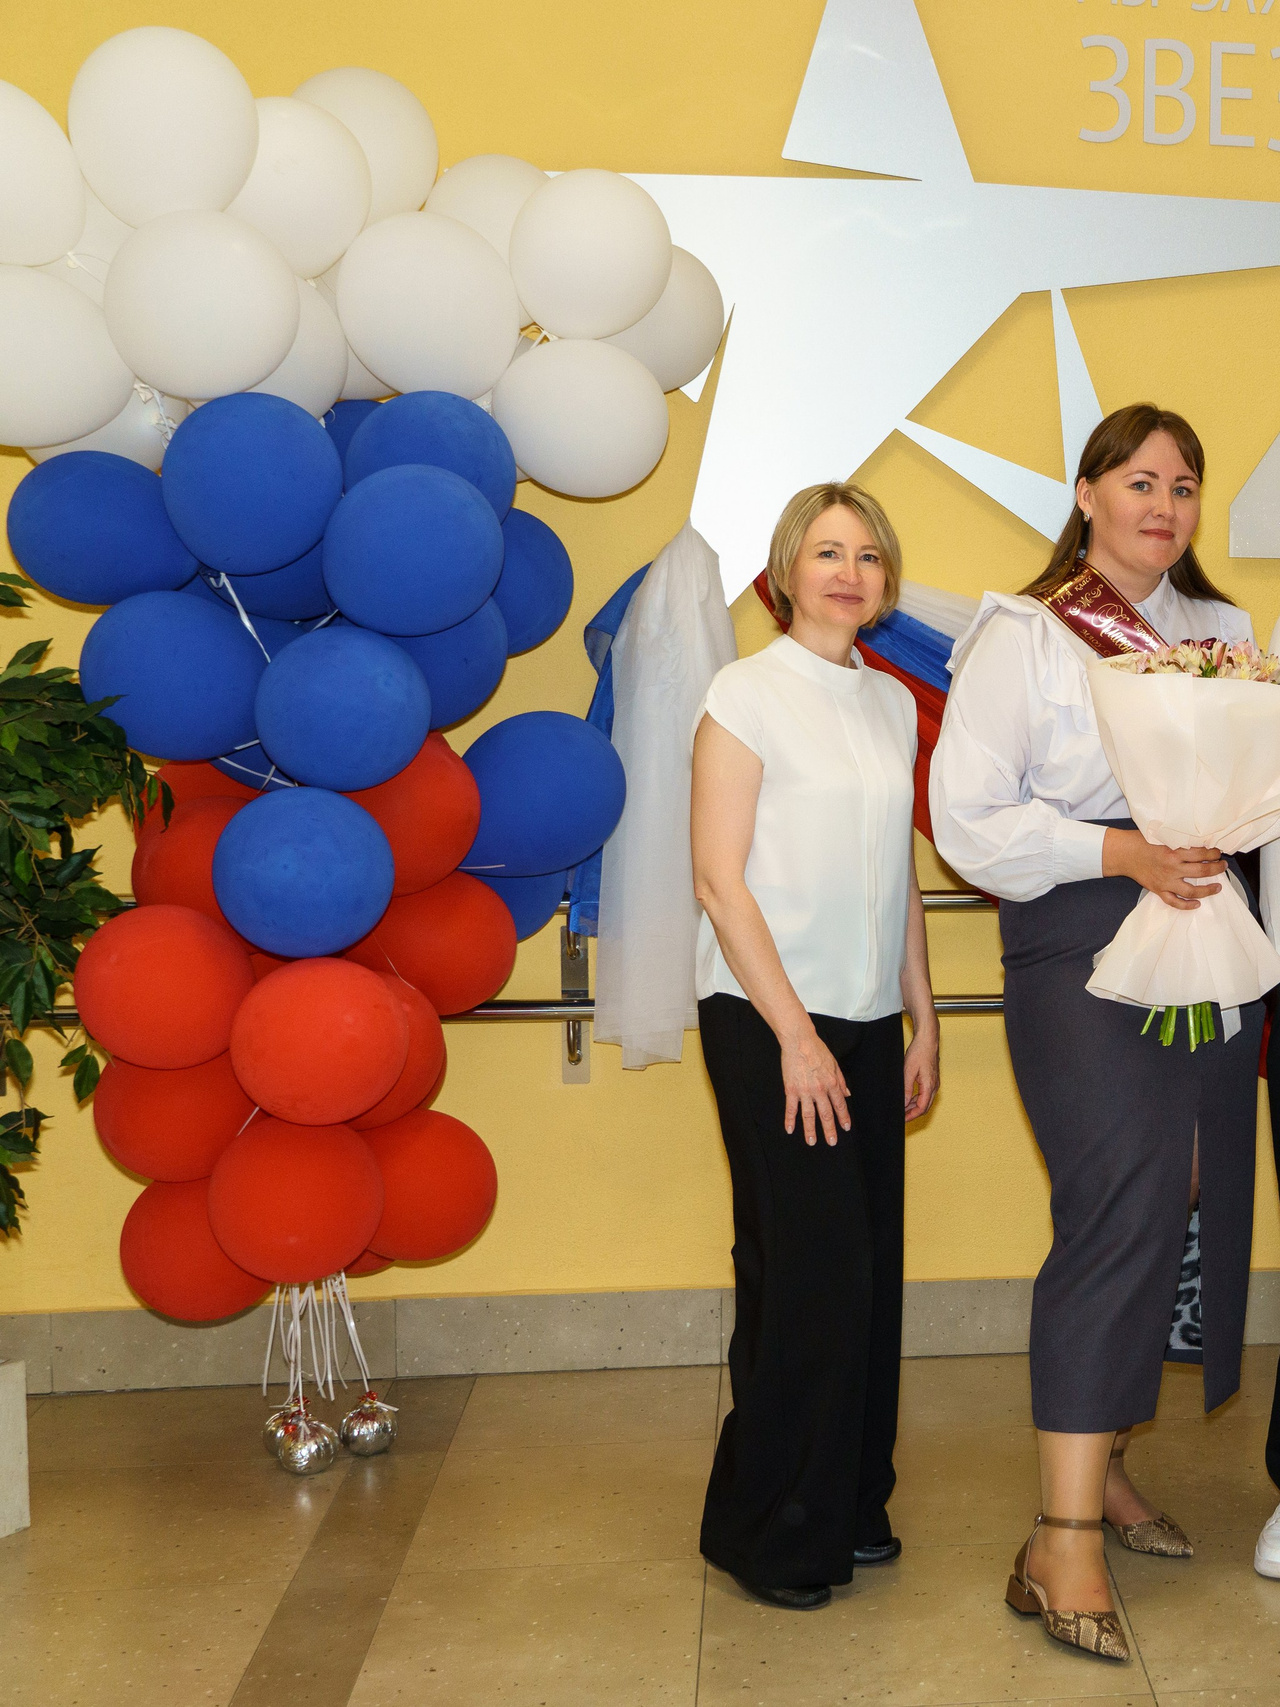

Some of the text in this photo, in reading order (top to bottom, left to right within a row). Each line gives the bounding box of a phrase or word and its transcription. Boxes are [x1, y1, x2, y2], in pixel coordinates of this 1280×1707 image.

[1057, 595, 1067, 606] 11
[1074, 575, 1093, 592] класс
[1091, 602, 1137, 653] Классн
